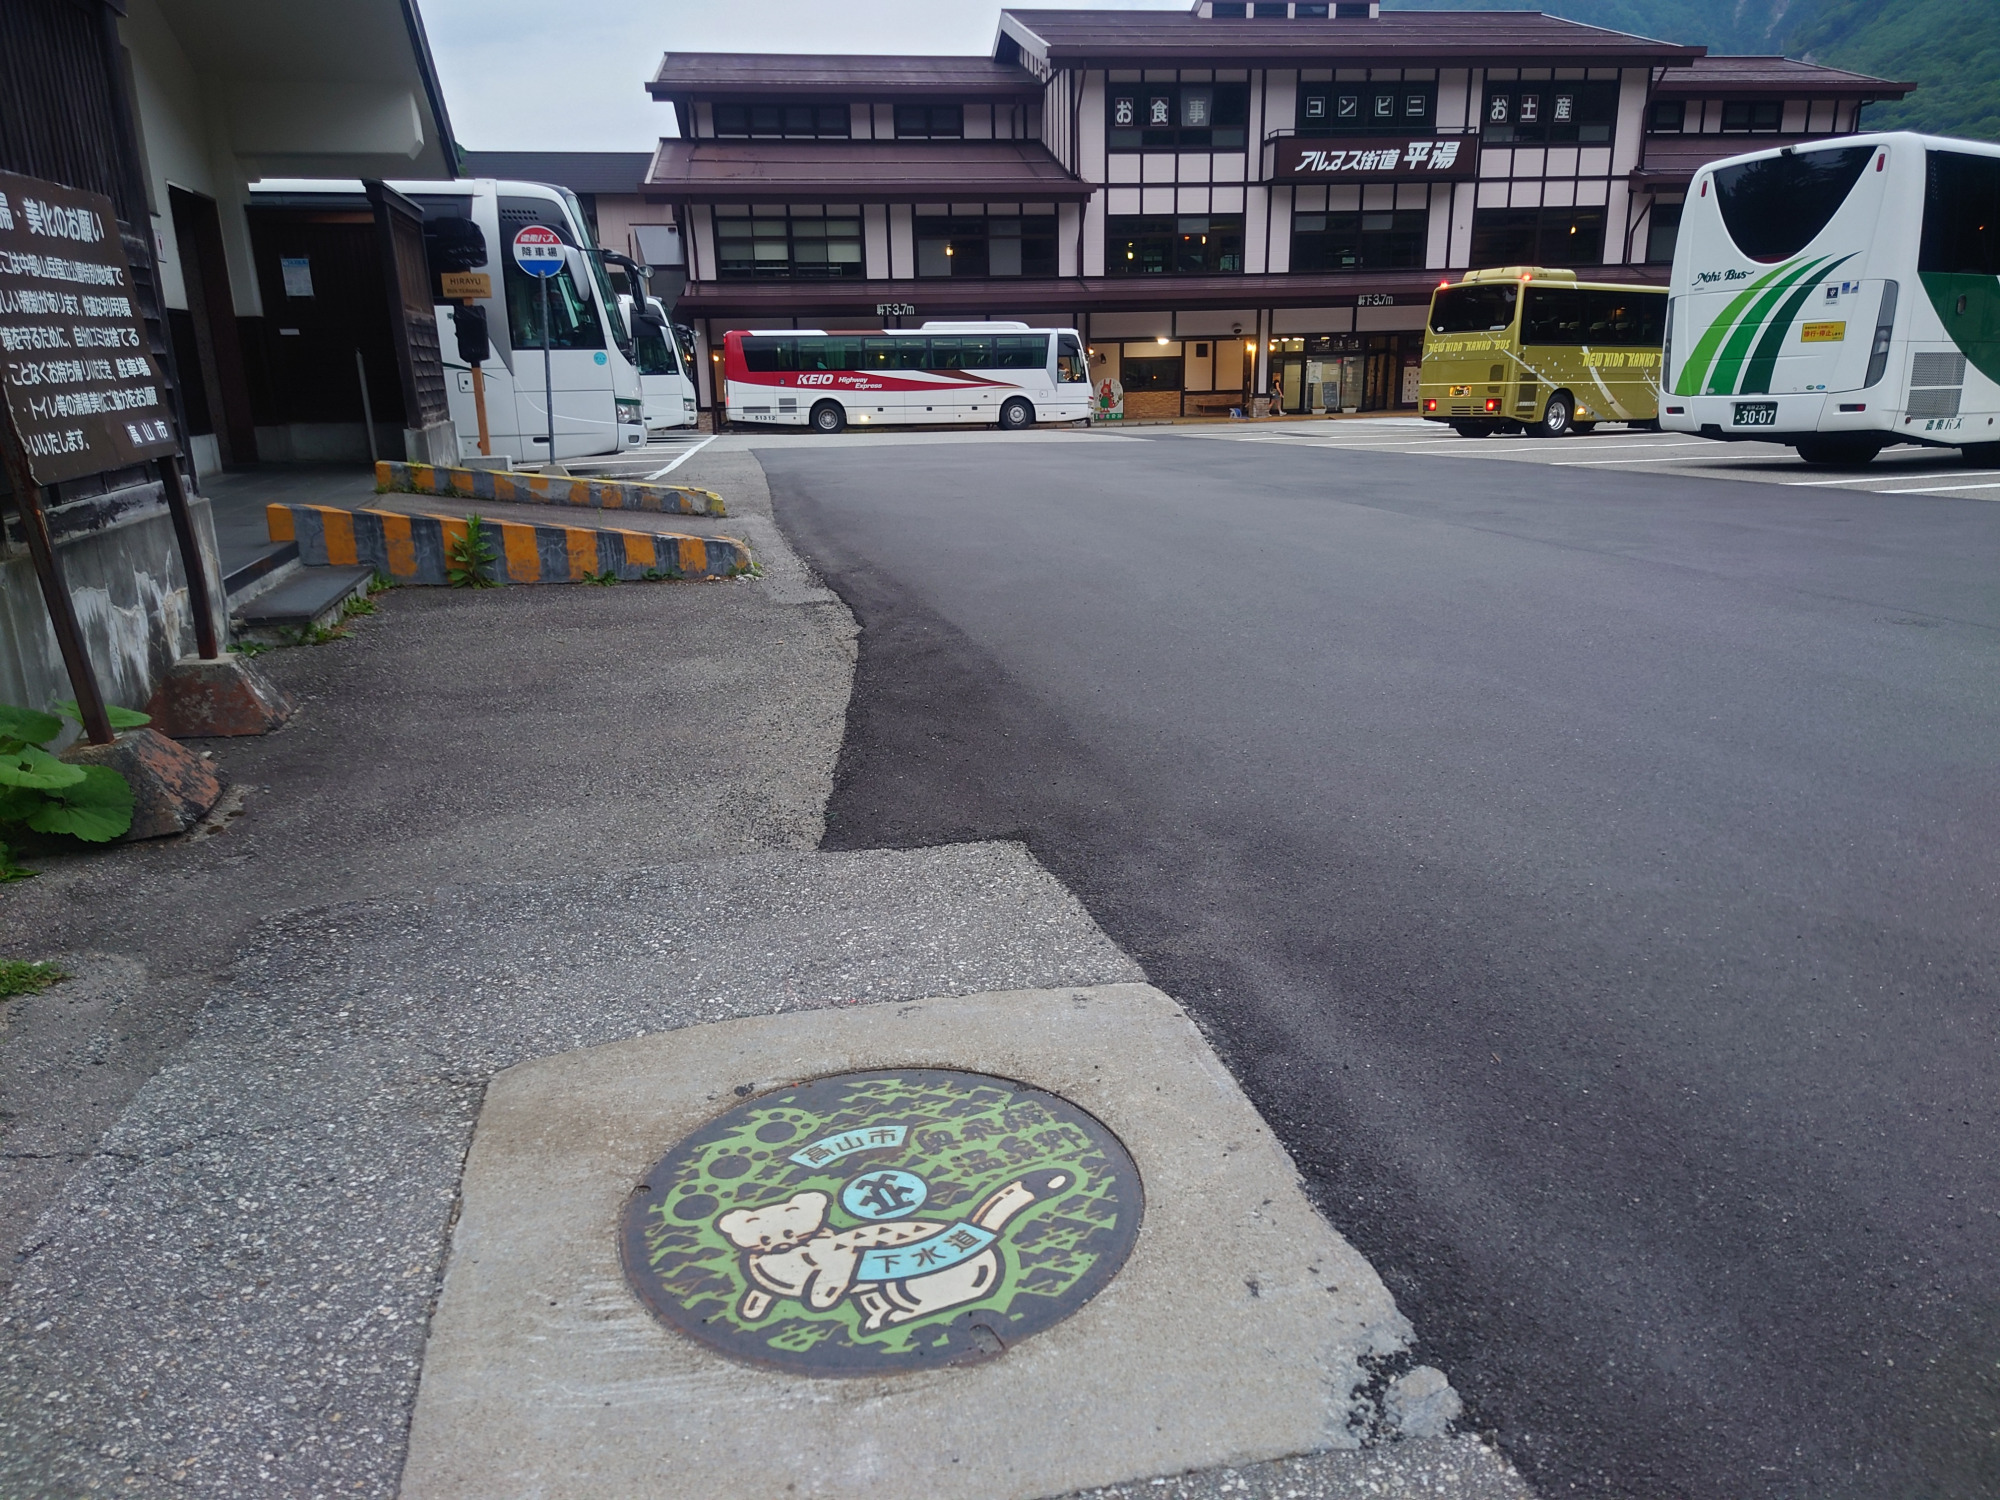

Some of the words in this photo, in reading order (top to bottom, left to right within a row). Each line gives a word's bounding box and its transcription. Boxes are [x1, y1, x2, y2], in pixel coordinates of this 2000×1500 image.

[1116, 100, 1205, 123] お食事
[1309, 98, 1423, 115] コンビニ
[1491, 97, 1571, 120] お土産
[1403, 141, 1461, 170] 平湯
[521, 246, 558, 258] 降車場
[450, 278, 482, 286] HIRAYU
[1691, 271, 1721, 286] Nohi
[1724, 269, 1755, 281] Bus
[1427, 342, 1445, 353] NEW
[1445, 341, 1463, 353] HIDA
[1464, 340, 1492, 352] KANKO
[1493, 339, 1511, 350] BUS
[1579, 352, 1603, 367] NEW
[1603, 352, 1624, 367] HIDA
[1625, 352, 1655, 367] KANKO
[796, 374, 834, 385] KEIO
[838, 376, 868, 385] Highway
[1740, 410, 1775, 424] 30-07
[128, 419, 169, 445] 高山市
[800, 1129, 897, 1165] 高山市
[873, 1229, 982, 1273] 下水道
